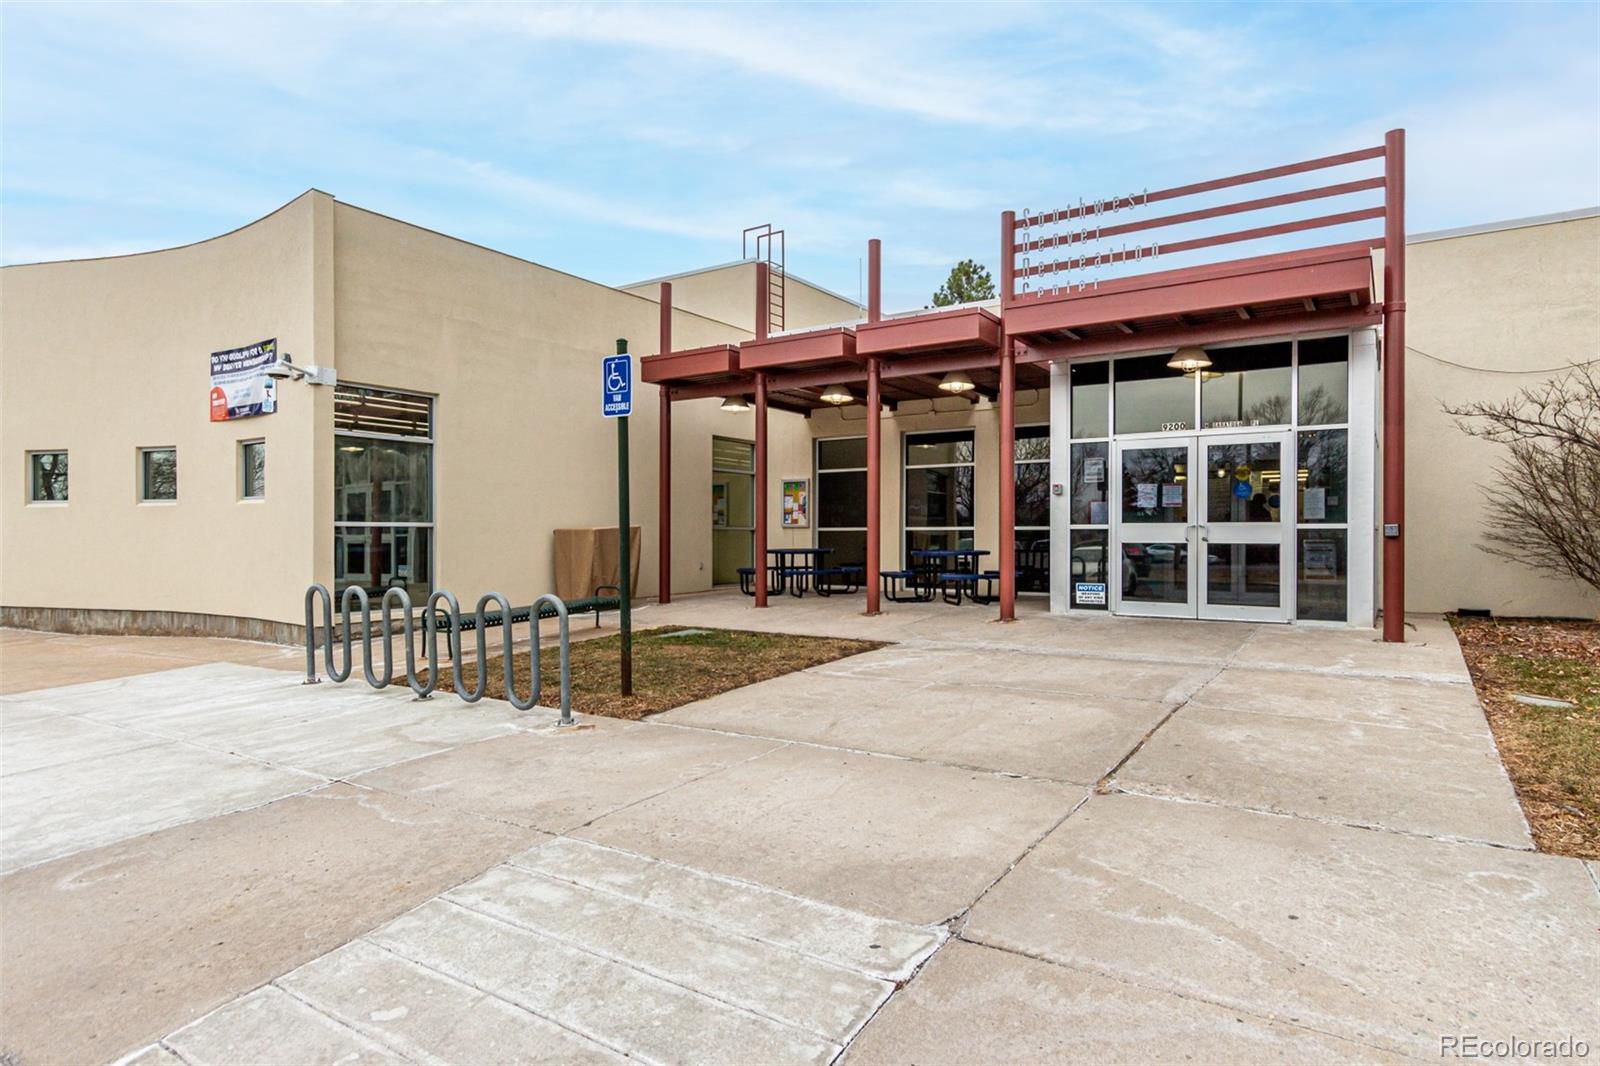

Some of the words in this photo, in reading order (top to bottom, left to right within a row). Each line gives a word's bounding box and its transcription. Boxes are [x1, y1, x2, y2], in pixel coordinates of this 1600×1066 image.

[1022, 187, 1148, 231] Southwest
[1022, 225, 1101, 255] Denver
[1022, 242, 1159, 280] Recreation
[605, 402, 629, 411] ACCESSIBLE
[1161, 422, 1186, 432] 9200
